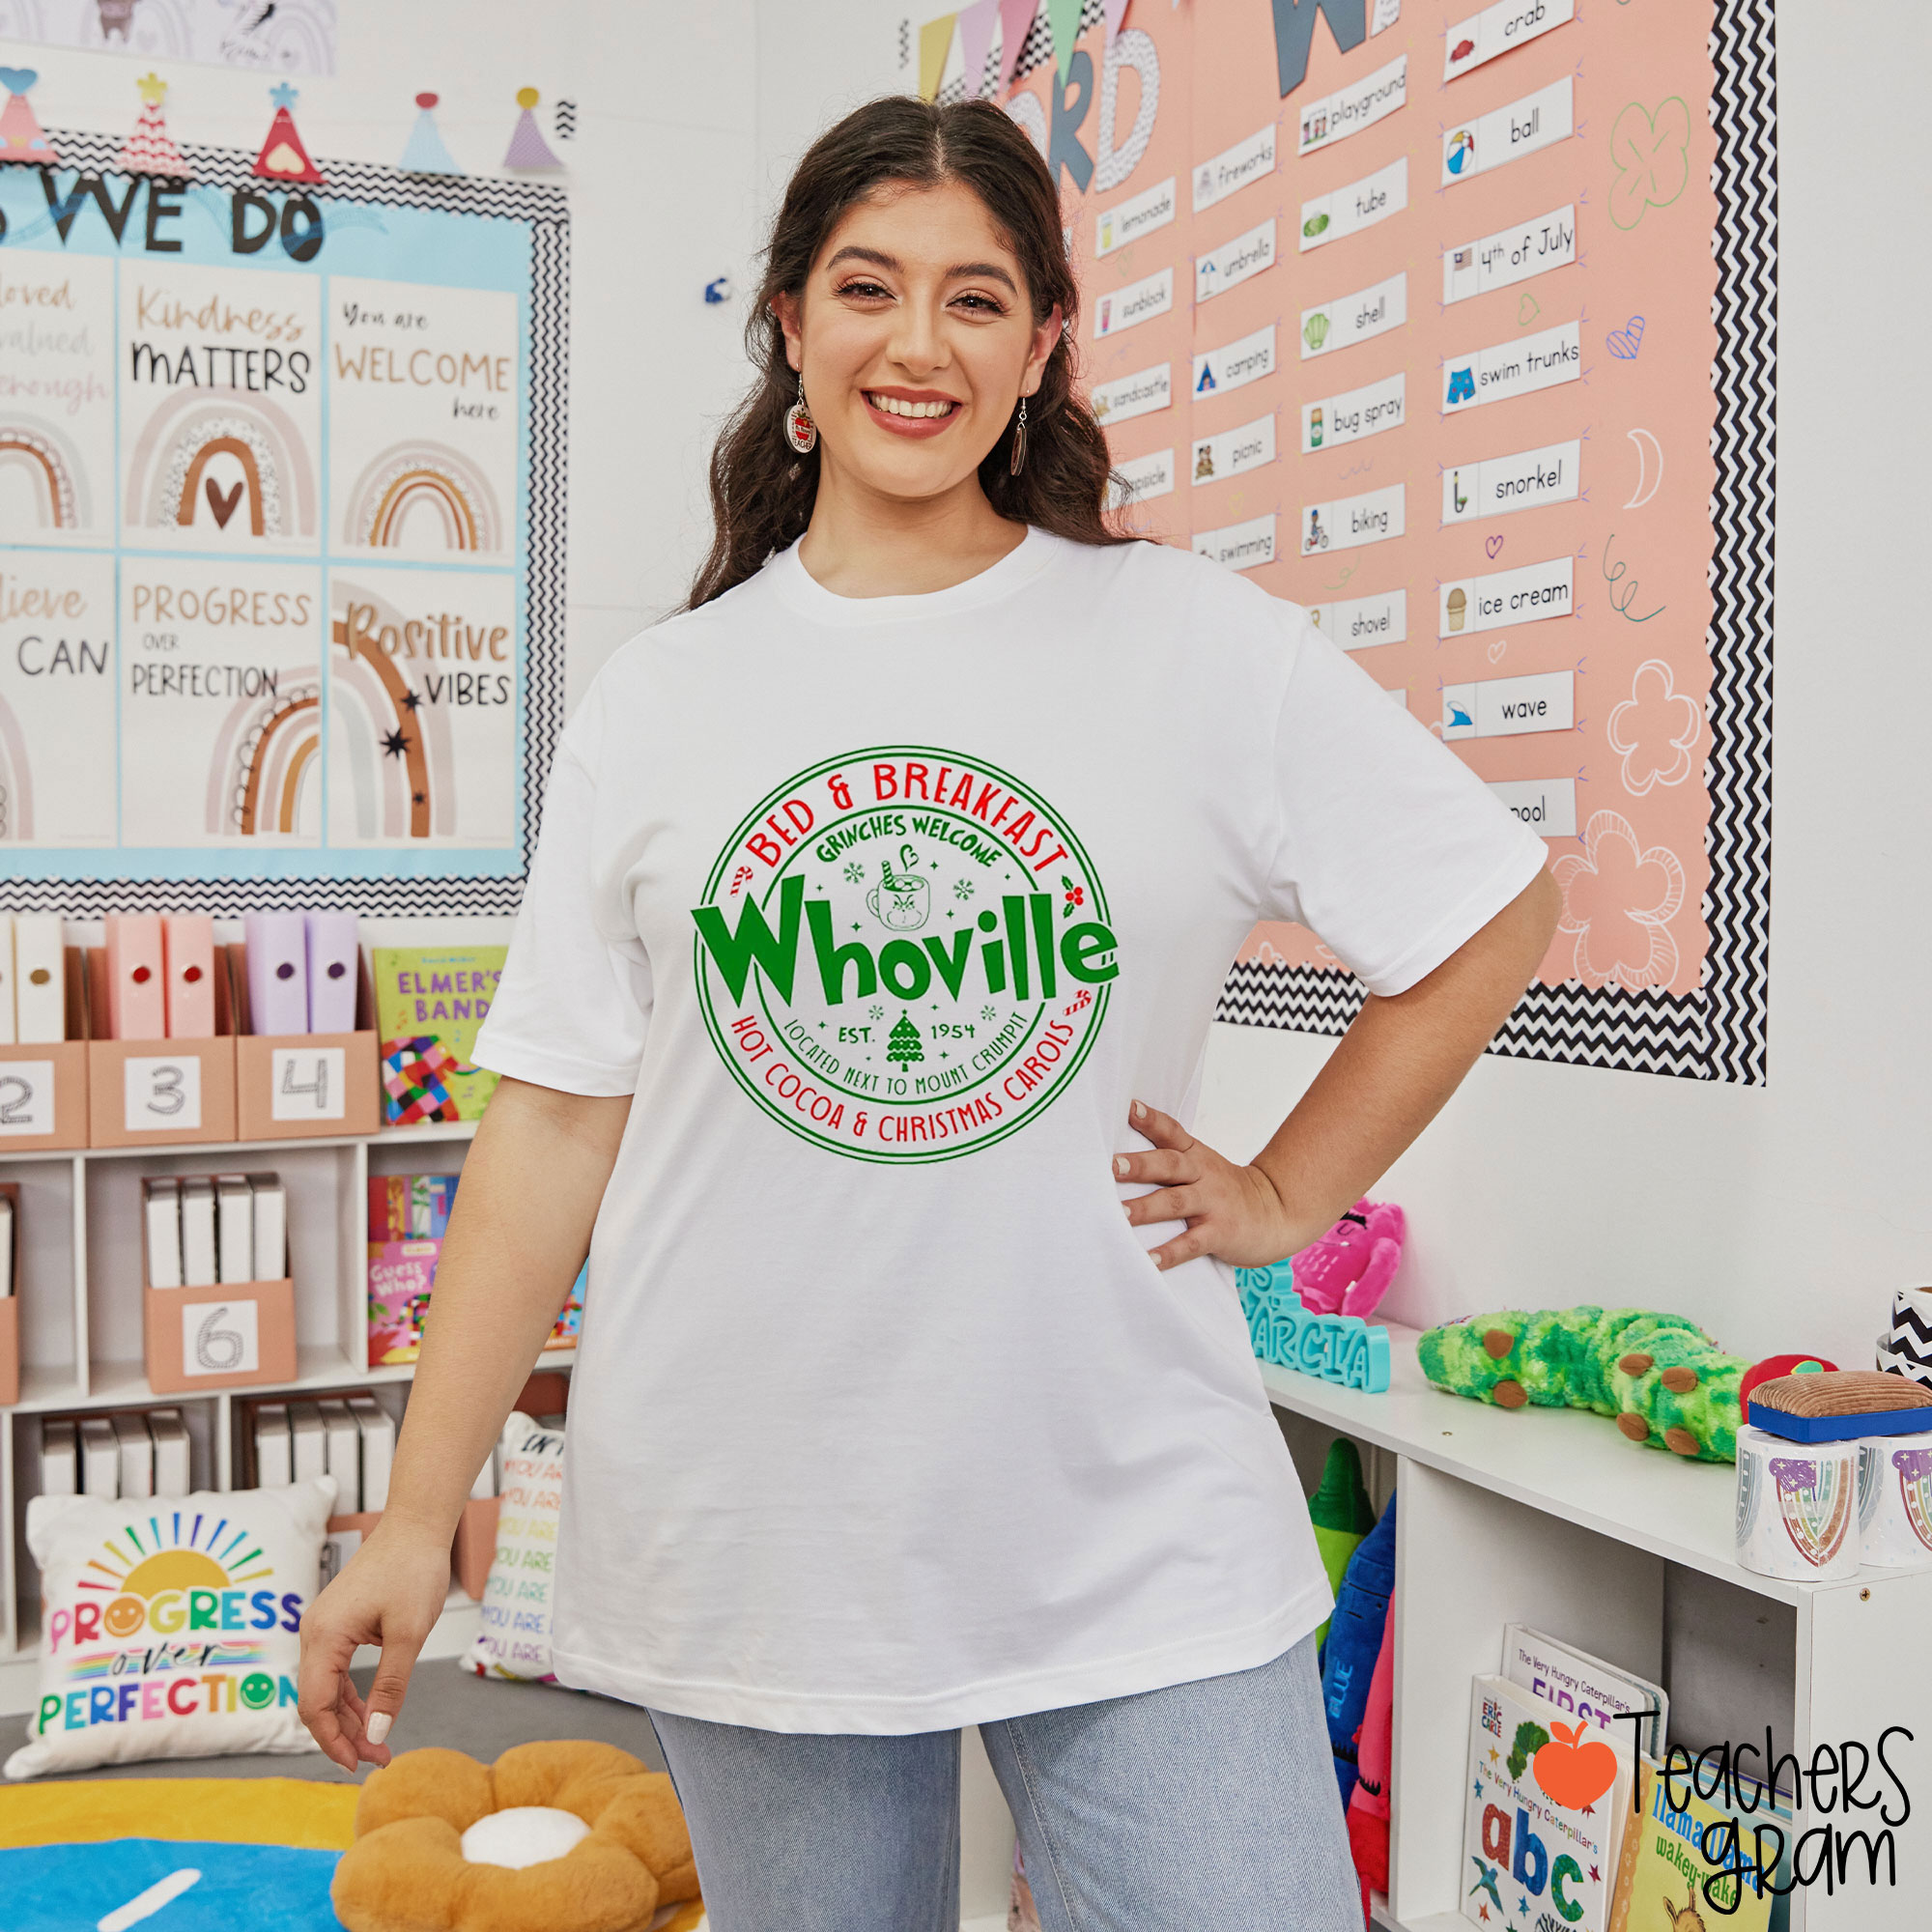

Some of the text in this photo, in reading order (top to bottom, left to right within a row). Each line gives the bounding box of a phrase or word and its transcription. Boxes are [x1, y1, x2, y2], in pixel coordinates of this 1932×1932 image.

[1504, 0, 1546, 37] crab
[1331, 65, 1407, 131] playground
[1511, 106, 1540, 144] ball
[1218, 141, 1273, 187] fireworks
[40, 166, 186, 252] WE
[232, 187, 325, 263] DO
[1122, 192, 1172, 233] lemonade
[1356, 188, 1387, 218] tube
[1224, 238, 1270, 277] umbrella
[1481, 223, 1574, 273] 4th of July
[135, 284, 304, 341] Kindness
[343, 302, 429, 331] You are
[1122, 283, 1166, 319] sunblock
[1356, 296, 1385, 329] shell
[335, 342, 511, 393] WELCOME
[1226, 349, 1269, 379] camping
[1480, 340, 1580, 386] swim trunks
[452, 396, 499, 421] here
[1113, 375, 1168, 409] sandcastle
[1335, 396, 1403, 434] bug spray
[1233, 440, 1263, 469] picnic
[1495, 459, 1562, 499] snorkel
[1351, 509, 1389, 533] biking
[1219, 536, 1273, 562] swimming
[132, 583, 313, 626] PROGRESS
[1478, 583, 1569, 617] ice cream
[346, 601, 510, 663] Positive
[1351, 607, 1391, 637] shovel
[17, 635, 109, 676] CAN
[143, 633, 180, 652] OVER
[132, 664, 278, 697] PERFECTION
[423, 672, 512, 706] VIBES
[1501, 700, 1548, 720] wave
[745, 761, 1069, 872] BED & BREAKFAST
[816, 814, 1003, 867] GRINCHES WELCOME
[690, 873, 1121, 1009] Whoville
[415, 999, 491, 1022] BAND
[838, 1023, 976, 1044] EST. 1954
[783, 1011, 1028, 1095] LOCATED NEXT TO MOUNT CRUMPIT
[147, 1065, 185, 1115] 3
[281, 1059, 327, 1109] 4
[730, 1015, 1074, 1143] HOT COCOA & CHRISTMAS CAROLS
[0, 1075, 33, 1123] 2
[370, 1262, 423, 1283] Guess
[374, 1273, 427, 1297] Who?
[197, 1307, 243, 1370] 6
[531, 1491, 561, 1512] AR
[496, 1546, 554, 1574] OU ARE
[51, 1589, 304, 1655] PROGRESS
[512, 1610, 546, 1634] ARE
[111, 1640, 249, 1676] over
[511, 1641, 544, 1662] ARE
[1328, 1661, 1353, 1719] BLUE
[1519, 1648, 1631, 1715] The Very Hungry Caterpillar's
[39, 1672, 299, 1735] PERFECTION
[1483, 1701, 1502, 1725] ERIC
[1481, 1715, 1502, 1739] CARLE
[1479, 1760, 1599, 1856] The Very Hungry Caterpillar's
[1652, 1782, 1703, 1852] llama
[1482, 1803, 1585, 1923] abc
